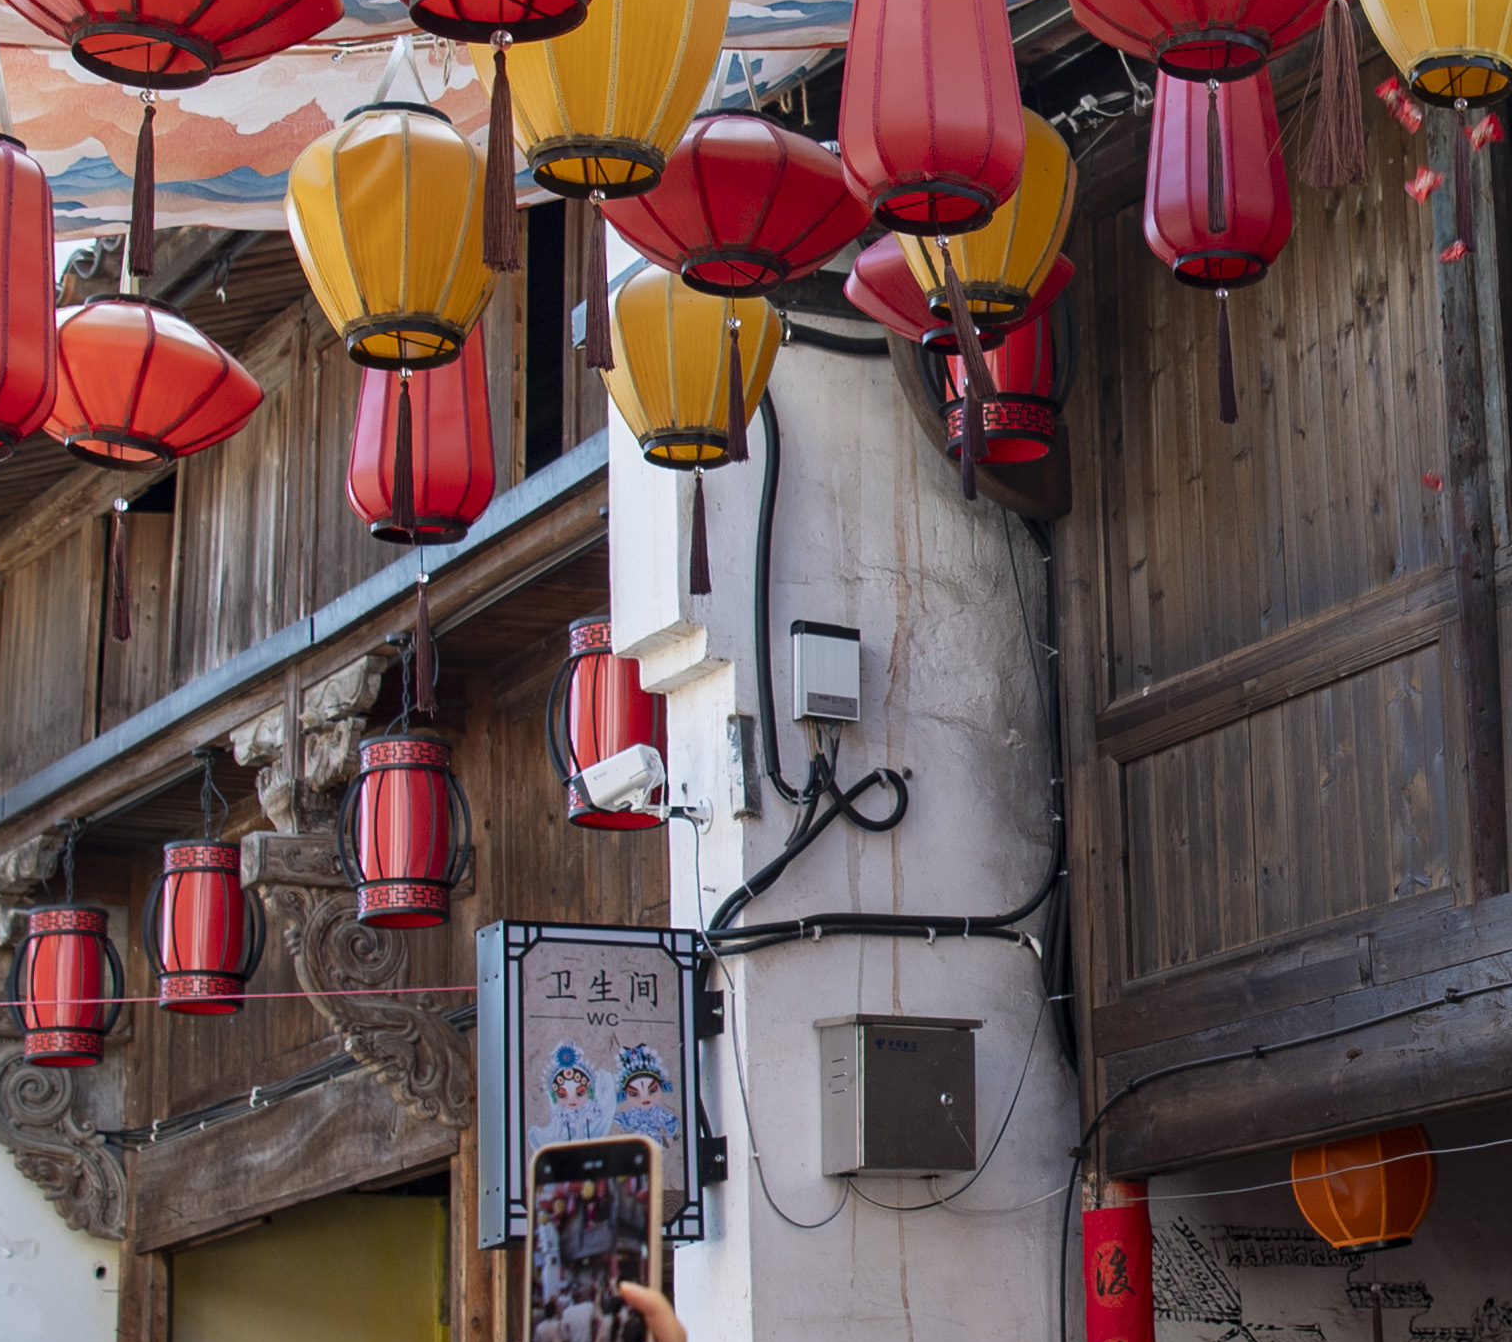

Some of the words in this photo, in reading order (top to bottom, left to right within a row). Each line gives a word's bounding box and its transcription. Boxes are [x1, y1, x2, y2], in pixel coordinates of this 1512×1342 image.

[546, 969, 658, 1008] 卫生间
[586, 1012, 620, 1027] WC
